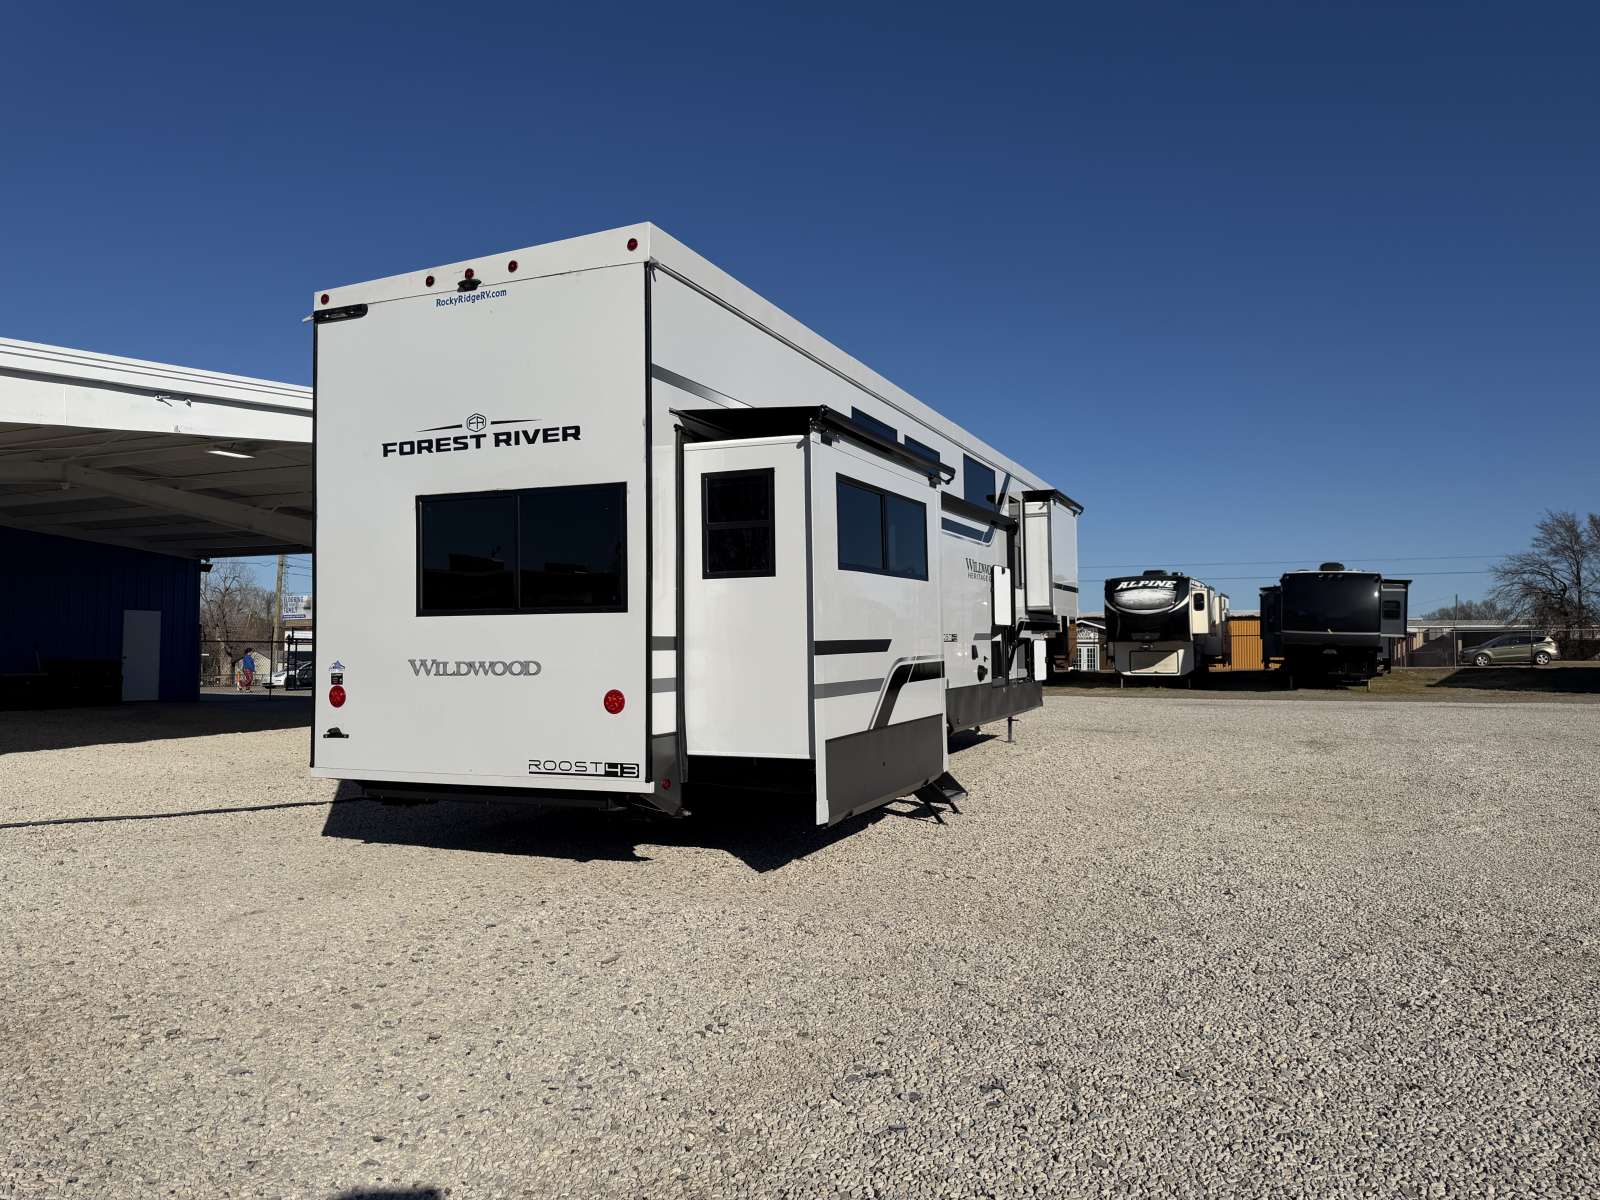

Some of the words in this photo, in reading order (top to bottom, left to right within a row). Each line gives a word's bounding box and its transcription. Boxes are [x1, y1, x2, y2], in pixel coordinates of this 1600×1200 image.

[436, 289, 507, 307] RockyRidgeRV.com
[382, 433, 487, 457] FOREST
[493, 425, 582, 447] RIVER
[1115, 580, 1178, 590] ALPINE
[408, 659, 542, 676] WILDWOOD
[528, 759, 603, 773] ROOST
